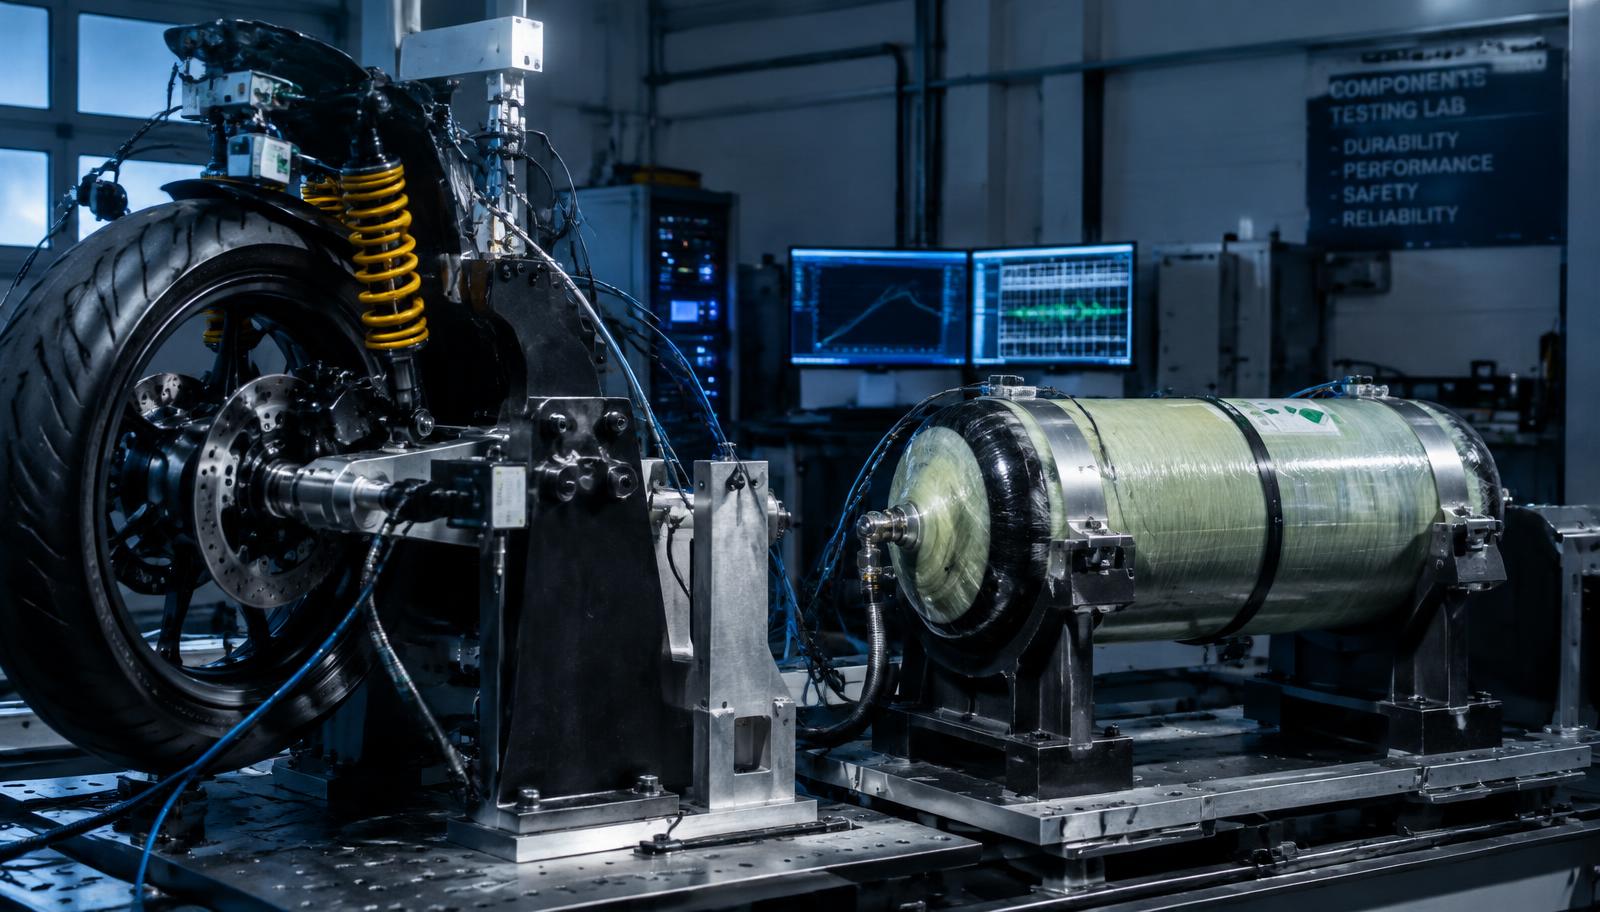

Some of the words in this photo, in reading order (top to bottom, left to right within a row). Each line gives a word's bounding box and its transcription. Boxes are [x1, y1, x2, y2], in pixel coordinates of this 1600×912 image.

[1329, 67, 1487, 98] COMPONENTS
[1330, 103, 1418, 125] TESTING
[1423, 96, 1467, 118] LAB
[1343, 131, 1460, 156] DURABILITY
[1343, 154, 1494, 180] PERFORMANCE
[1343, 183, 1419, 205] SAFETY
[1342, 206, 1459, 228] RELIABILITY
